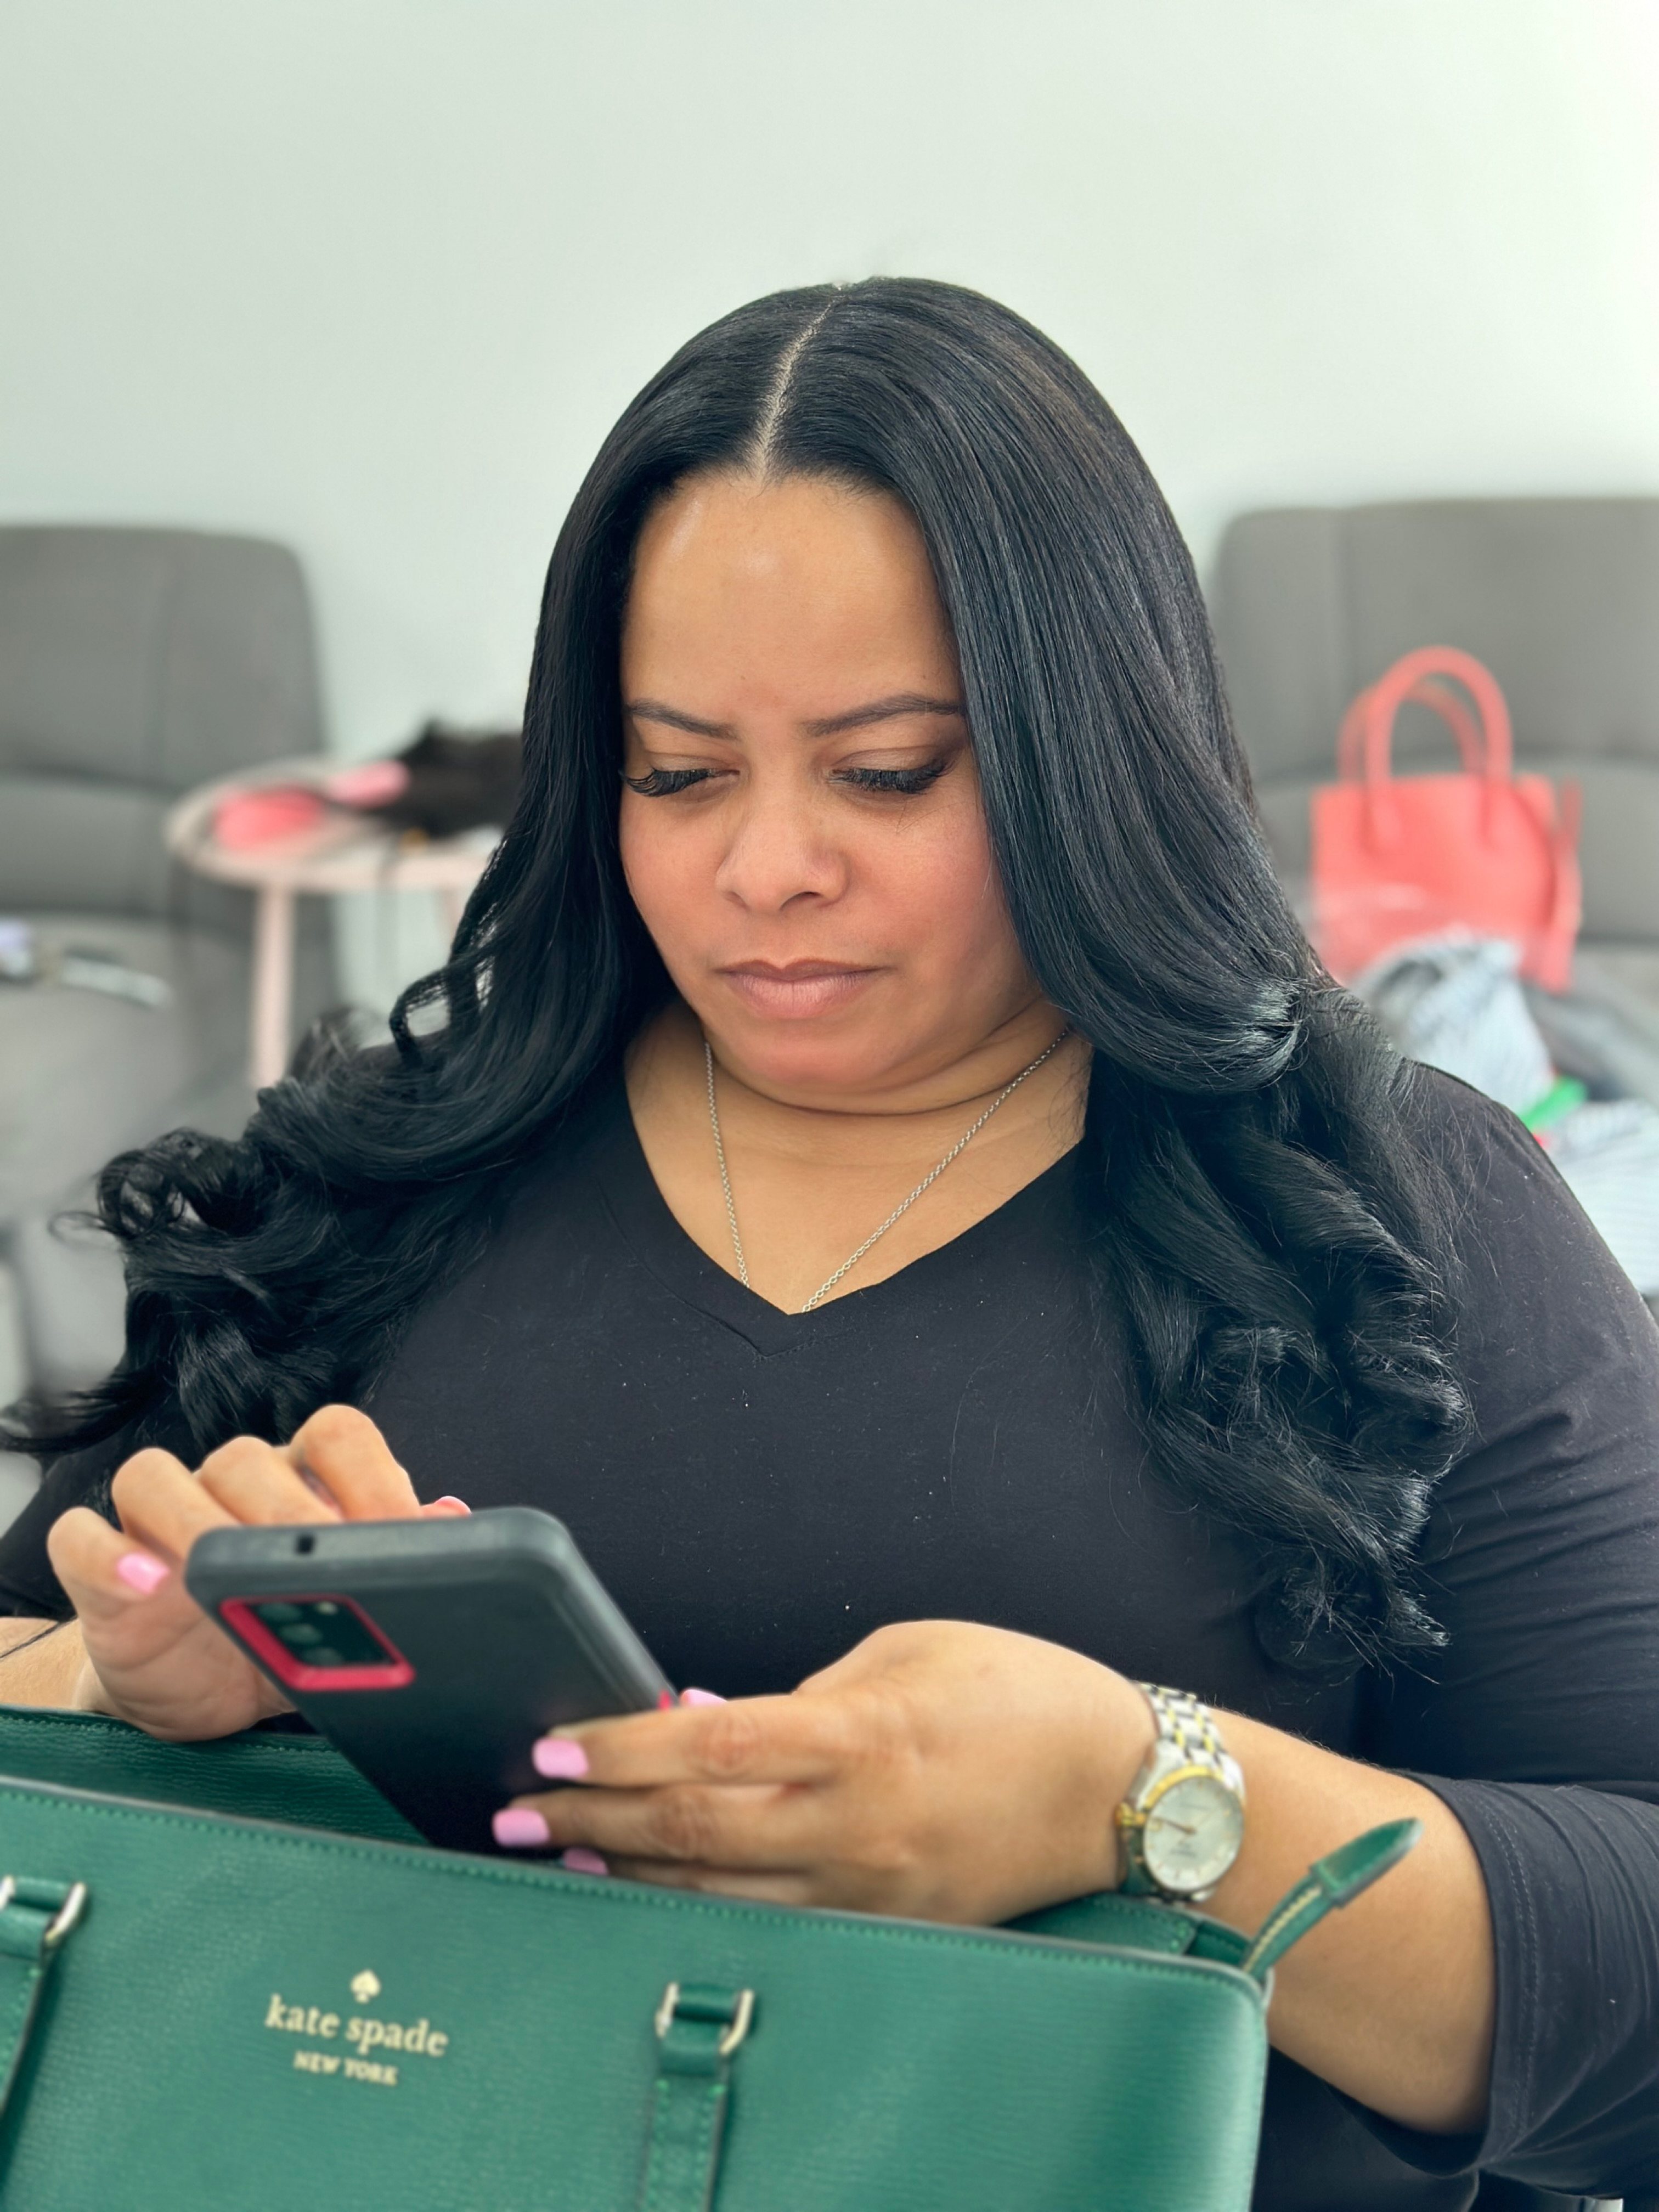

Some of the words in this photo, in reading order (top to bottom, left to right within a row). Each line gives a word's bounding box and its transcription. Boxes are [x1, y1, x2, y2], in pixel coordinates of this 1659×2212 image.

[266, 1993, 340, 2038] kate
[346, 2017, 449, 2057] spade
[294, 2050, 341, 2074] NEW
[343, 2057, 398, 2086] YORK
